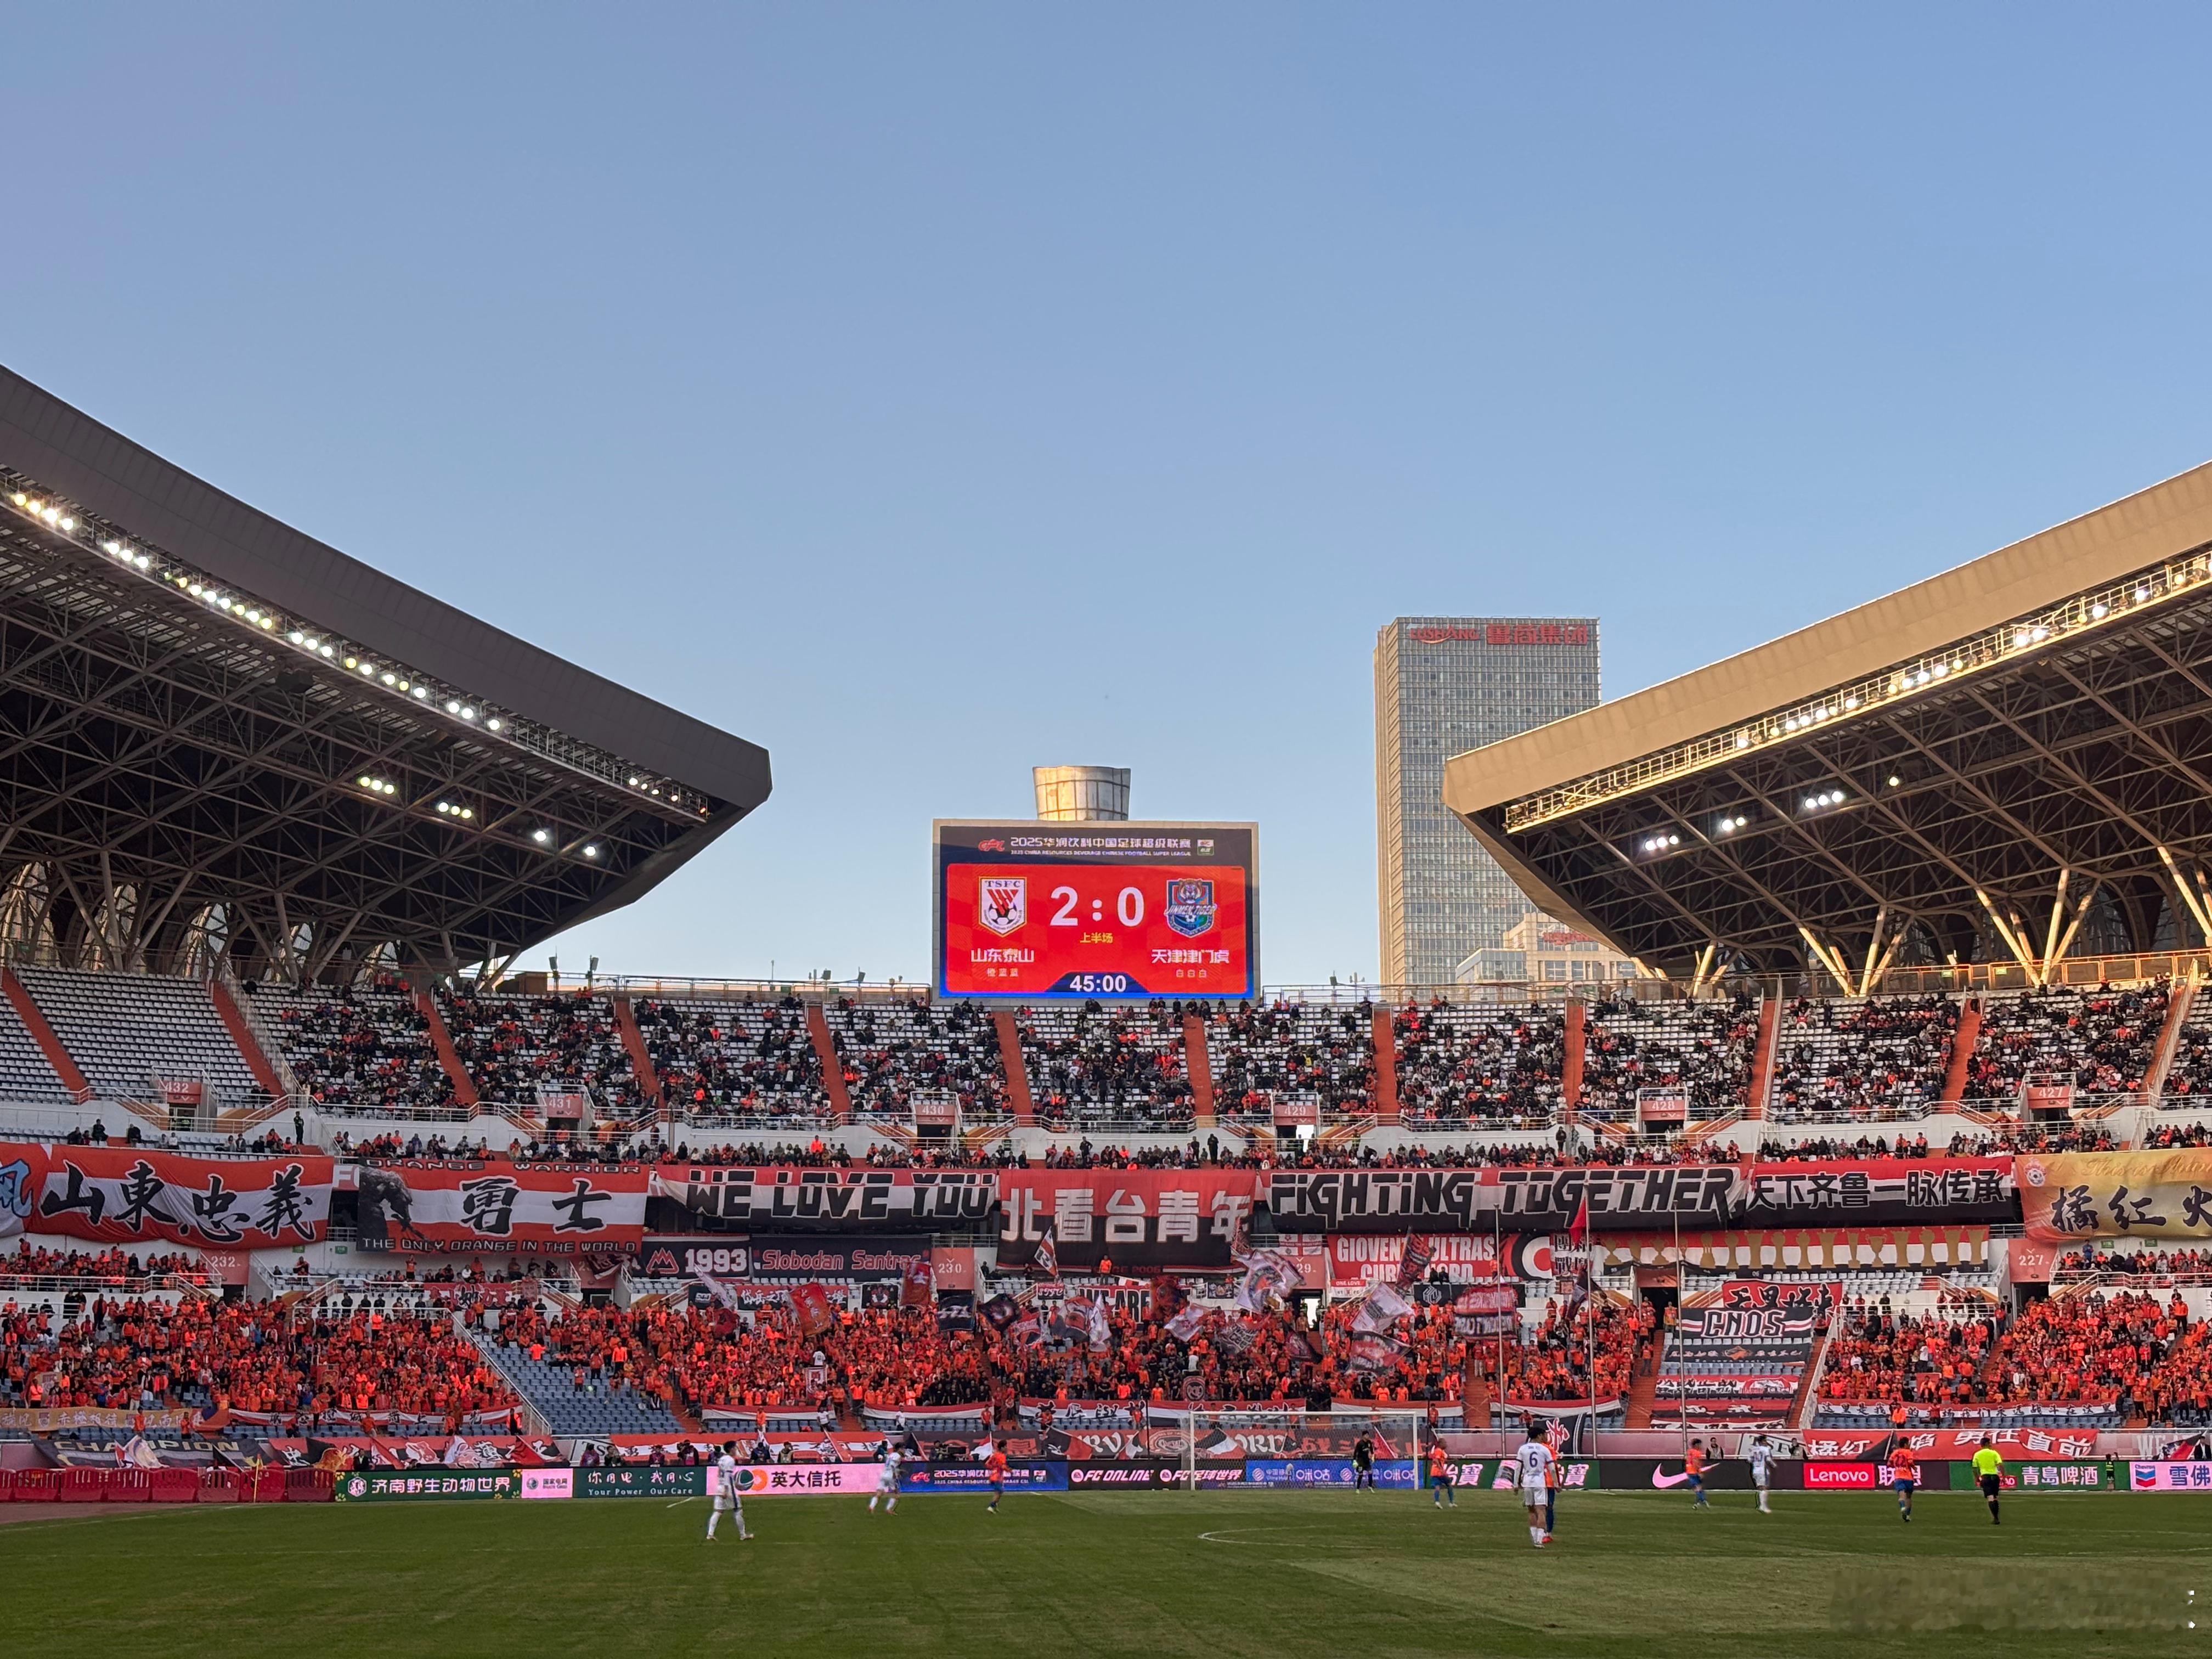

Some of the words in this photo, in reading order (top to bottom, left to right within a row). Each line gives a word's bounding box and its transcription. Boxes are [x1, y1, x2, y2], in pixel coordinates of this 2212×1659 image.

[1409, 625, 1480, 640] LUSHANG
[1080, 932, 1113, 944] 上半场
[970, 948, 1035, 963] 山东泰山
[1152, 949, 1229, 964] 天津津门虎
[1070, 975, 1126, 992] 45:00
[166, 1082, 189, 1093] 432
[2039, 1087, 2063, 1098] 427
[550, 1099, 571, 1109] 431
[922, 1105, 944, 1115] 430
[1284, 1105, 1306, 1116] 429
[1651, 1101, 1675, 1110] 428
[366, 1159, 485, 1171] ORANGE
[514, 1162, 641, 1173] WARRIOR
[686, 1169, 756, 1218] WE
[771, 1171, 895, 1219] LOVE
[911, 1172, 997, 1219] YOU
[1747, 1169, 2008, 1211] 天下齐鲁一脉传承
[40, 1159, 317, 1242] 山東忠義
[1270, 1171, 1477, 1229] FIGHTING
[1498, 1167, 1735, 1229] TOGETHER
[1001, 1187, 1252, 1243] 北看台青年
[362, 1238, 395, 1249] THE
[402, 1238, 445, 1252] ONLY
[450, 1240, 517, 1252] ORANGE
[521, 1240, 537, 1252] IN
[544, 1242, 575, 1252] THE
[581, 1242, 636, 1253] WORLD
[1337, 1235, 1406, 1262] GIOVEN
[1429, 1235, 1496, 1261] ULTRAS
[211, 1256, 235, 1267] 232
[685, 1248, 747, 1273] 1993
[762, 1249, 843, 1271] Slobodan
[2018, 1255, 2044, 1266] 227
[939, 1263, 962, 1273] 230
[1822, 1402, 2112, 1418] 这里是我的场我们永远战斗在这里
[1235, 1434, 1285, 1453] ORD
[1808, 1434, 1936, 1457] 橘红焰
[1530, 1451, 1538, 1468] 6
[771, 1470, 842, 1488] 英大信托
[1084, 1470, 1104, 1481] FC
[1103, 1470, 1152, 1481] ONLINE
[1810, 1468, 1869, 1482] Lenovo
[2169, 1465, 2211, 1486] 雪佛
[371, 1476, 511, 1494] 济南野生动物世界
